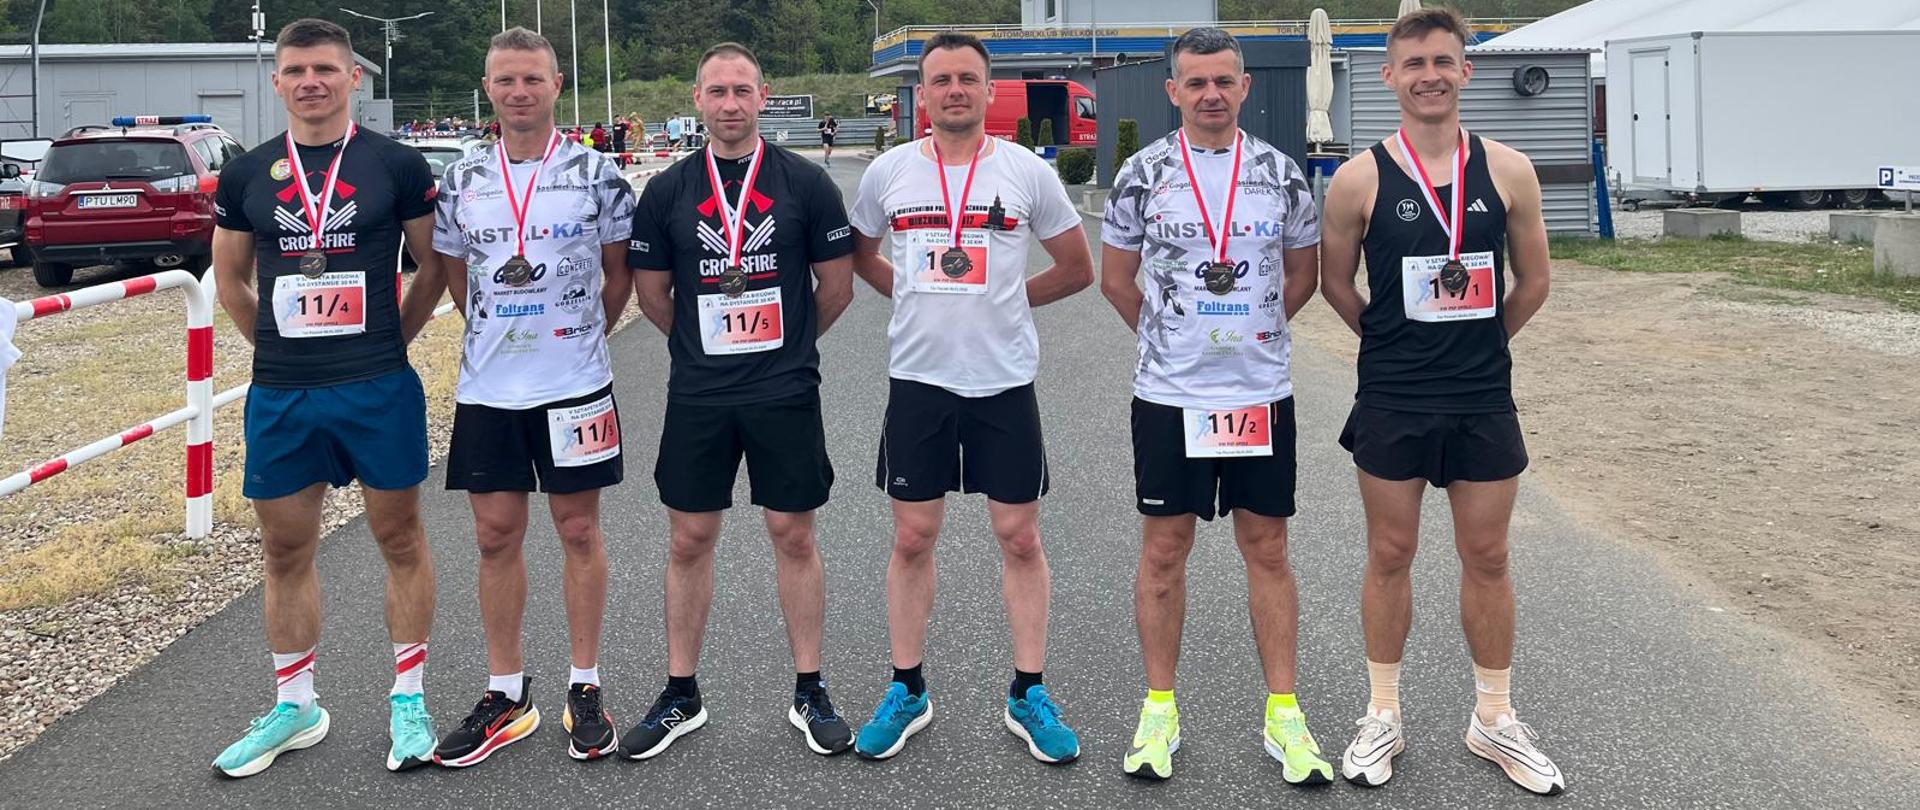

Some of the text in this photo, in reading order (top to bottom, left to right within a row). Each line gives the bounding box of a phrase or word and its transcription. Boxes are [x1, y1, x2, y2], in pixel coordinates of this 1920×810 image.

[84, 195, 136, 208] PTU LM90
[699, 253, 778, 278] CROSFIRE
[297, 294, 349, 317] 11/4
[495, 304, 545, 314] Foltrans
[1197, 301, 1250, 312] Foltrans
[722, 311, 769, 334] 11/5
[1208, 413, 1256, 437] 11/2
